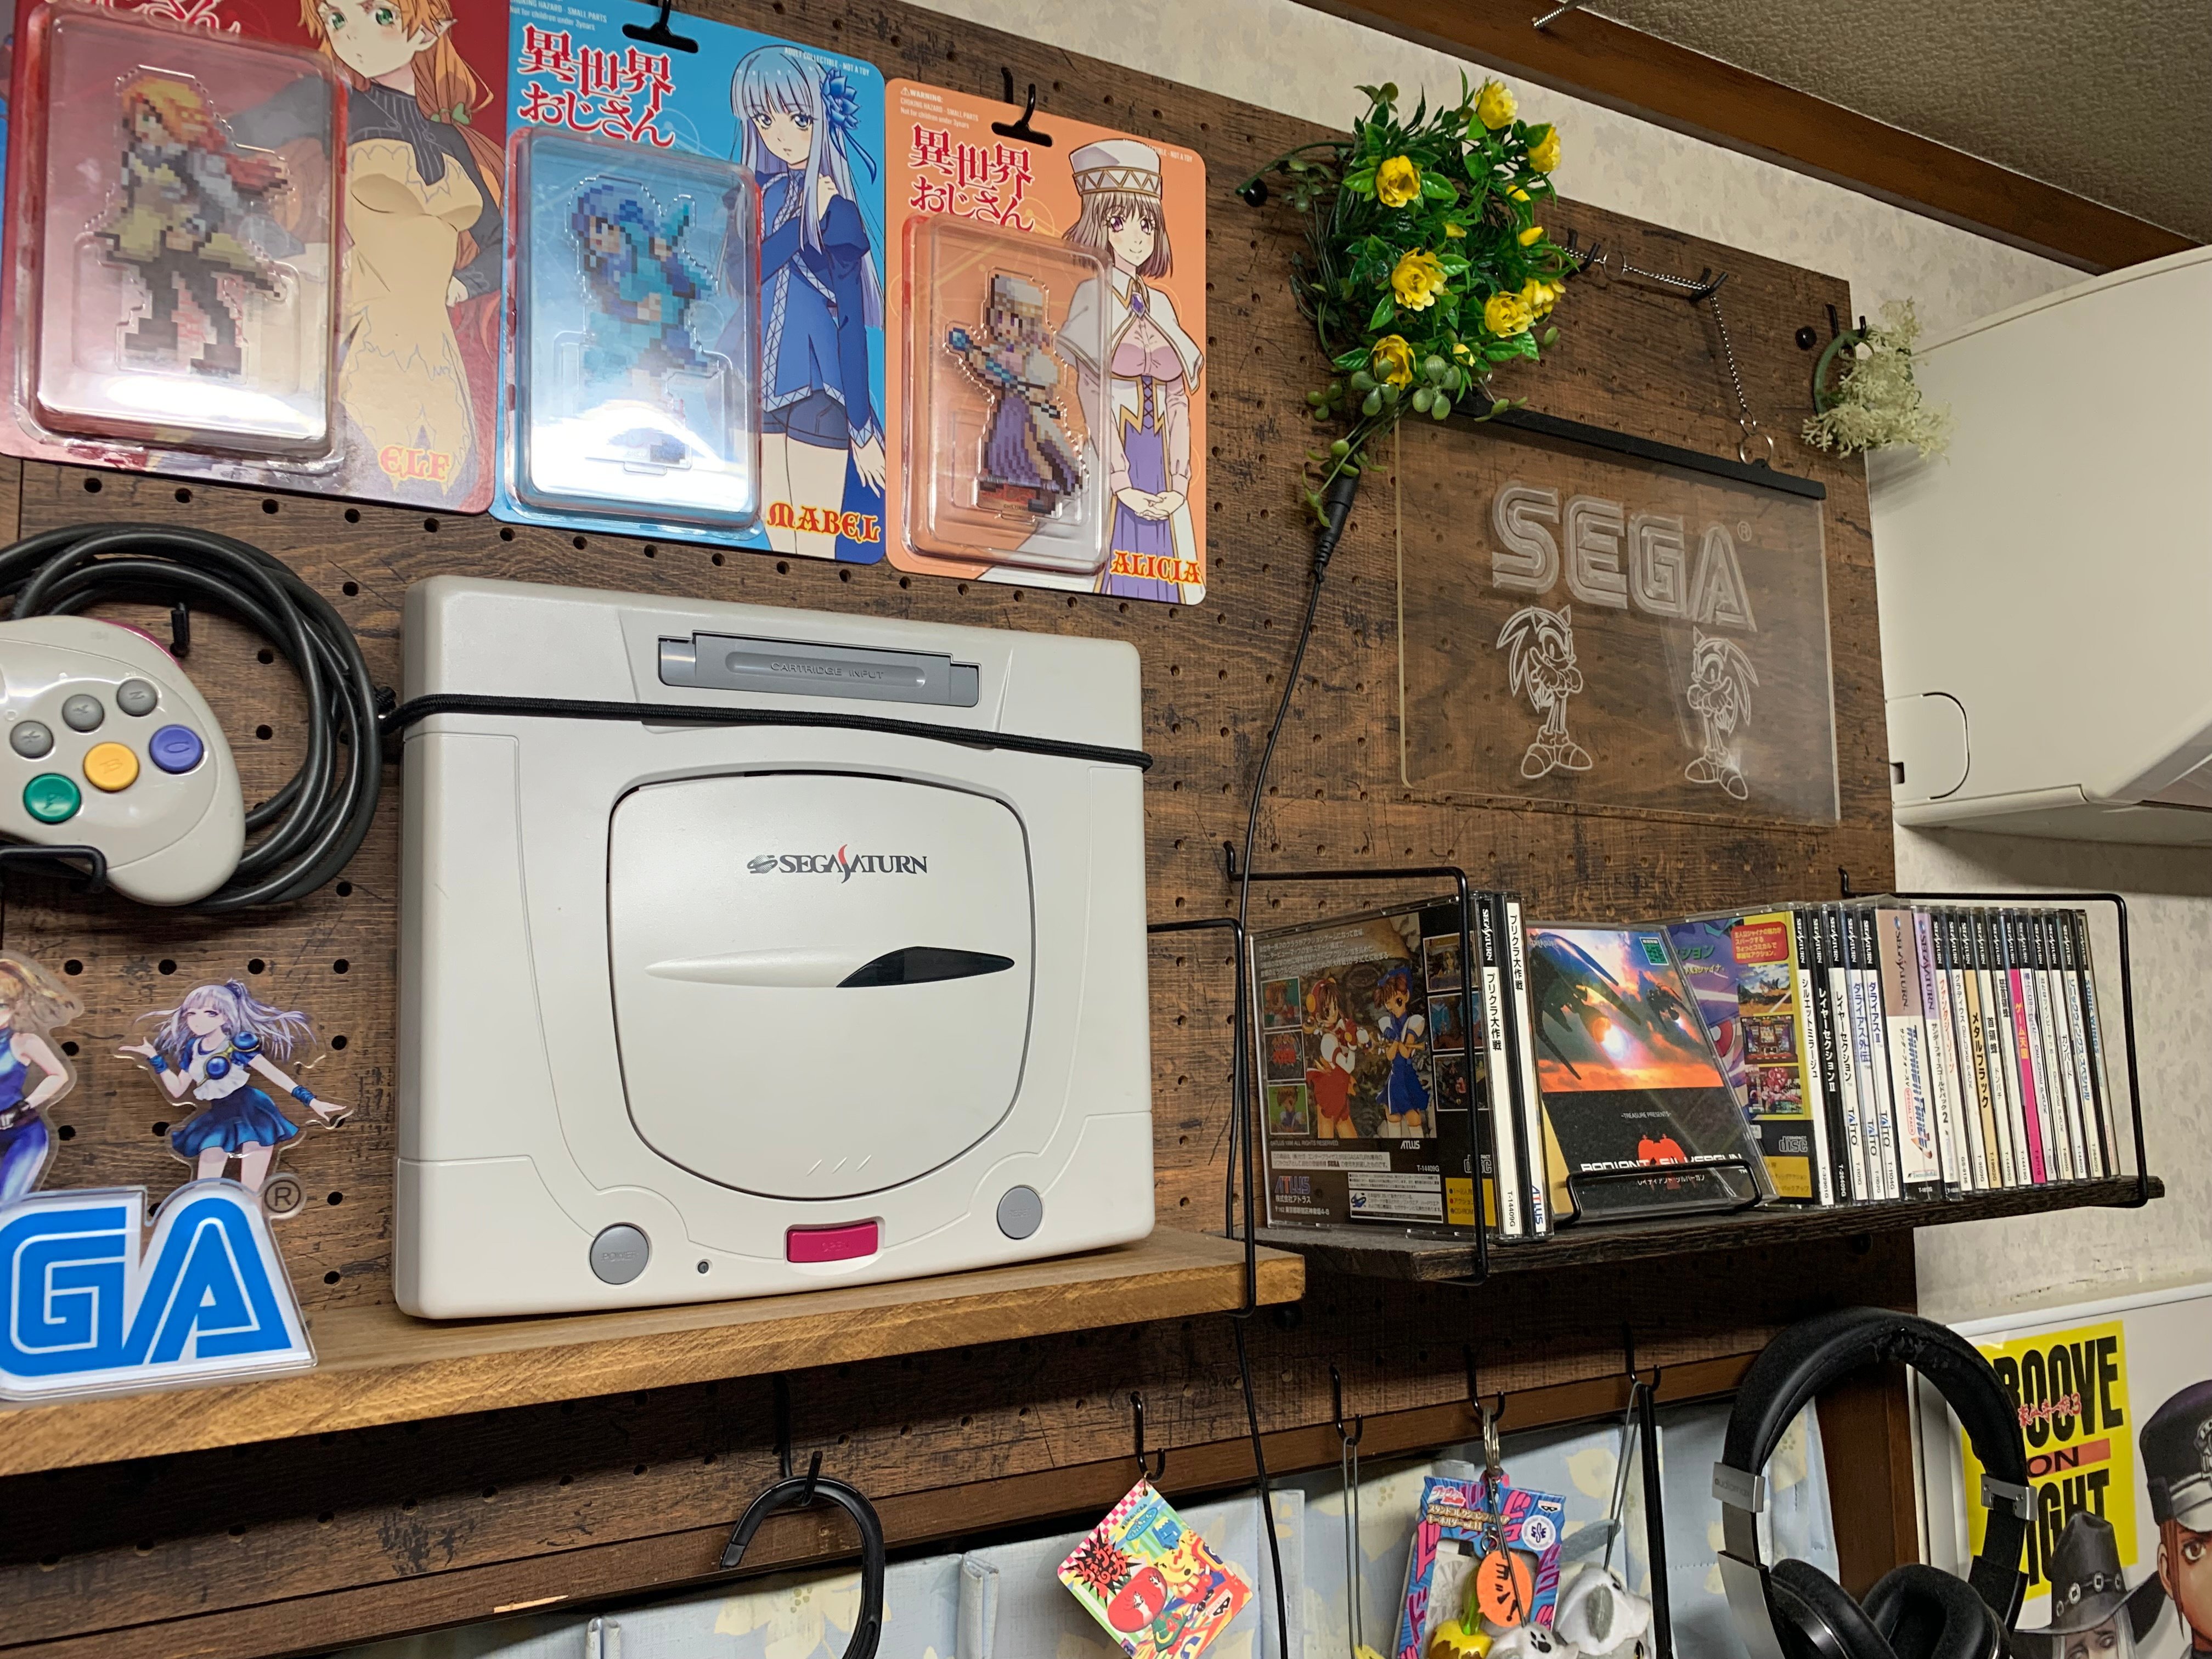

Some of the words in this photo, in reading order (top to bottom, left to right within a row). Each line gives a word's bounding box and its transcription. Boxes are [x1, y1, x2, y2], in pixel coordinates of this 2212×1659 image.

[567, 7, 586, 18] SMALL
[588, 11, 607, 23] PARTS
[518, 22, 676, 111] 異世界
[785, 47, 802, 58] ADULT
[803, 52, 838, 68] COLLECTIBLE
[843, 62, 853, 71] NOT
[518, 82, 676, 146] おじさん
[910, 89, 944, 103] WARNING:
[947, 108, 962, 117] SMALL
[963, 111, 979, 121] PARTS
[908, 123, 1035, 202] 異世界
[908, 174, 1035, 232] おじさん
[380, 446, 452, 484] ELF
[768, 501, 879, 544] MABEL
[1110, 549, 1204, 586] ALICIA
[1492, 480, 1757, 633] SEGA
[770, 662, 843, 676] CARTRIDGE
[848, 669, 884, 680] INPUT
[1510, 915, 1523, 991] プリクラ大作戦
[1487, 973, 1502, 1051] プリクラ大作戦
[2085, 980, 2094, 1012] SONIC
[1802, 979, 1818, 1077] シルエットミラージュ
[1836, 991, 1852, 1081] レイヤーセクション
[1853, 981, 1871, 1063] ダライアス外伝
[1940, 979, 1954, 1074] ファンタジーゾーン
[1955, 974, 1966, 1022] グラディウス
[1961, 1025, 1970, 1062] DELUXE
[2015, 1003, 2029, 1059] ゲーム天国
[2089, 1015, 2099, 1054] WINGS
[1973, 1013, 1989, 1108] メタルブラック
[2062, 1035, 2073, 1080] ガンバード
[1401, 1140, 1420, 1150] ATLUS
[1779, 1136, 1808, 1153] disc
[1274, 1175, 1311, 1194] ATLUS
[1276, 1195, 1311, 1204] 株式会社アトラス
[1532, 1184, 1543, 1225] ATLUS
[1507, 1190, 1516, 1227] T-14409G
[2027, 1446, 2079, 1478] ON
